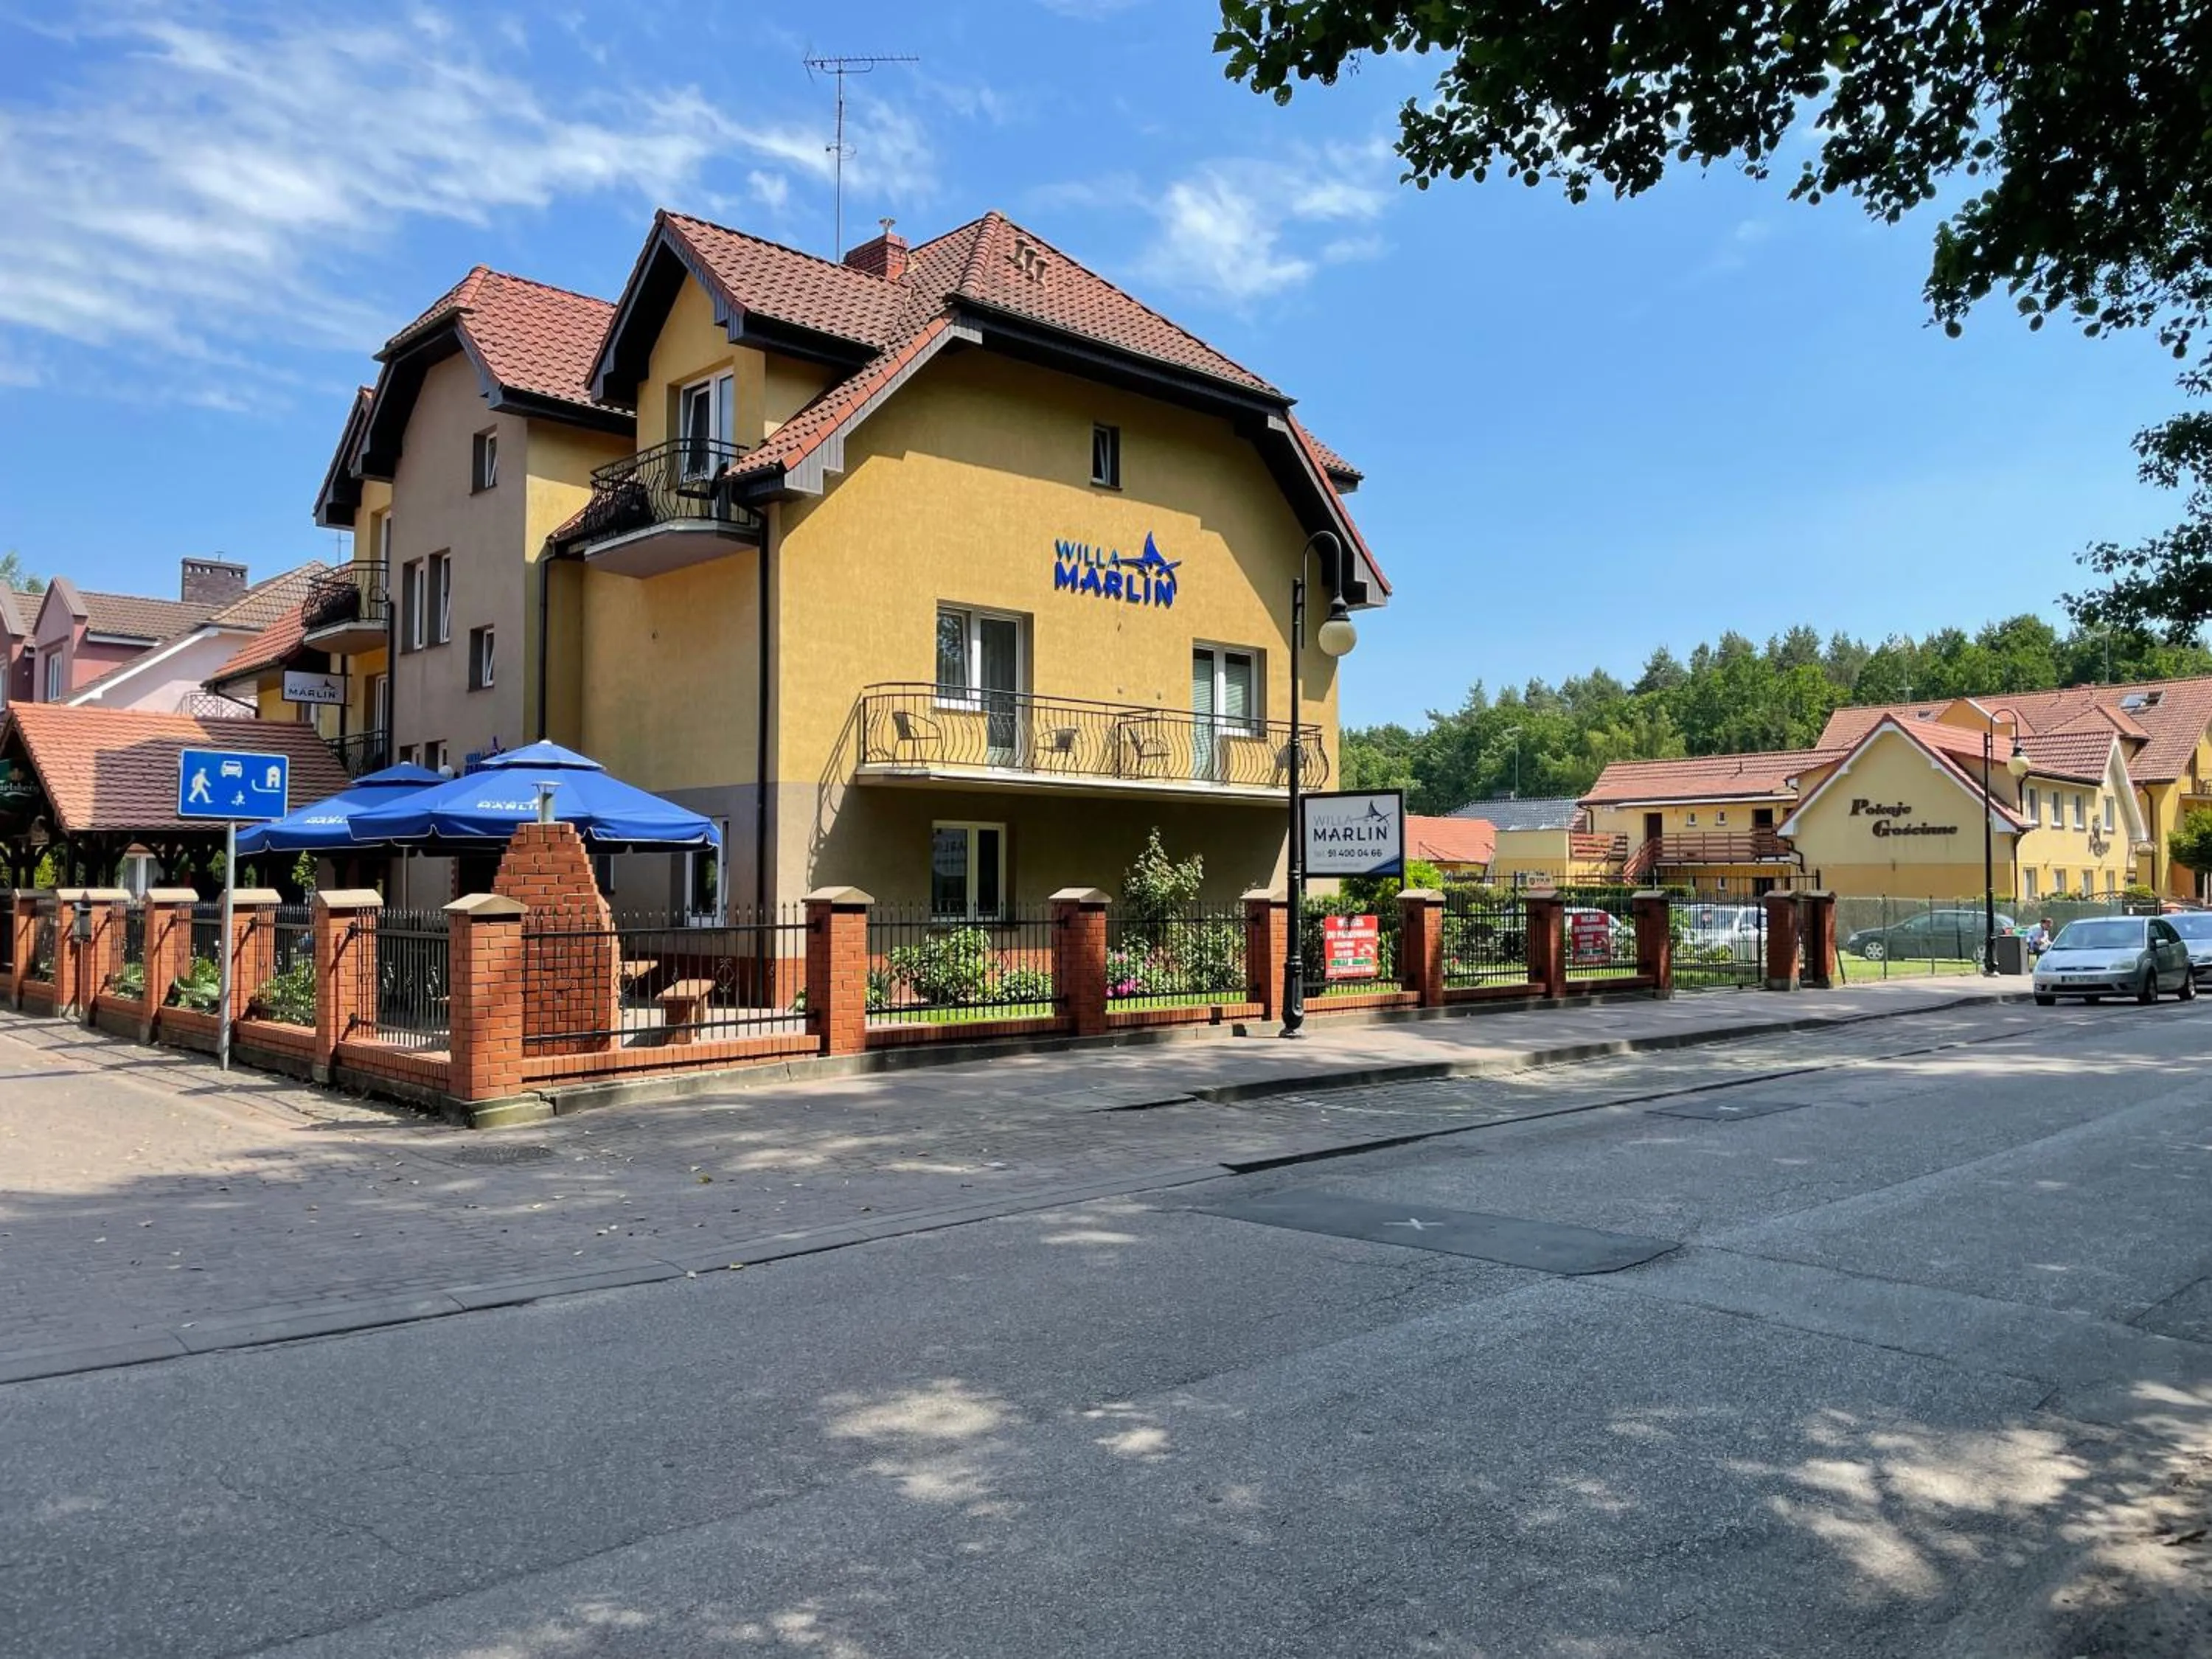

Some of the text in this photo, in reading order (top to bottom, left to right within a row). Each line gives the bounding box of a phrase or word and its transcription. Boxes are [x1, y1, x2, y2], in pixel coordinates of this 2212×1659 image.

[1054, 539, 1121, 571] WILLA
[1054, 561, 1174, 609] MARLIN
[288, 688, 335, 699] MARLIN
[1849, 799, 1912, 818] Pokoje
[1314, 814, 1353, 826] WILLA
[1313, 827, 1387, 841] MARLIN
[1328, 849, 1336, 858] 91
[1338, 849, 1355, 858] 400
[1371, 849, 1382, 857] 66
